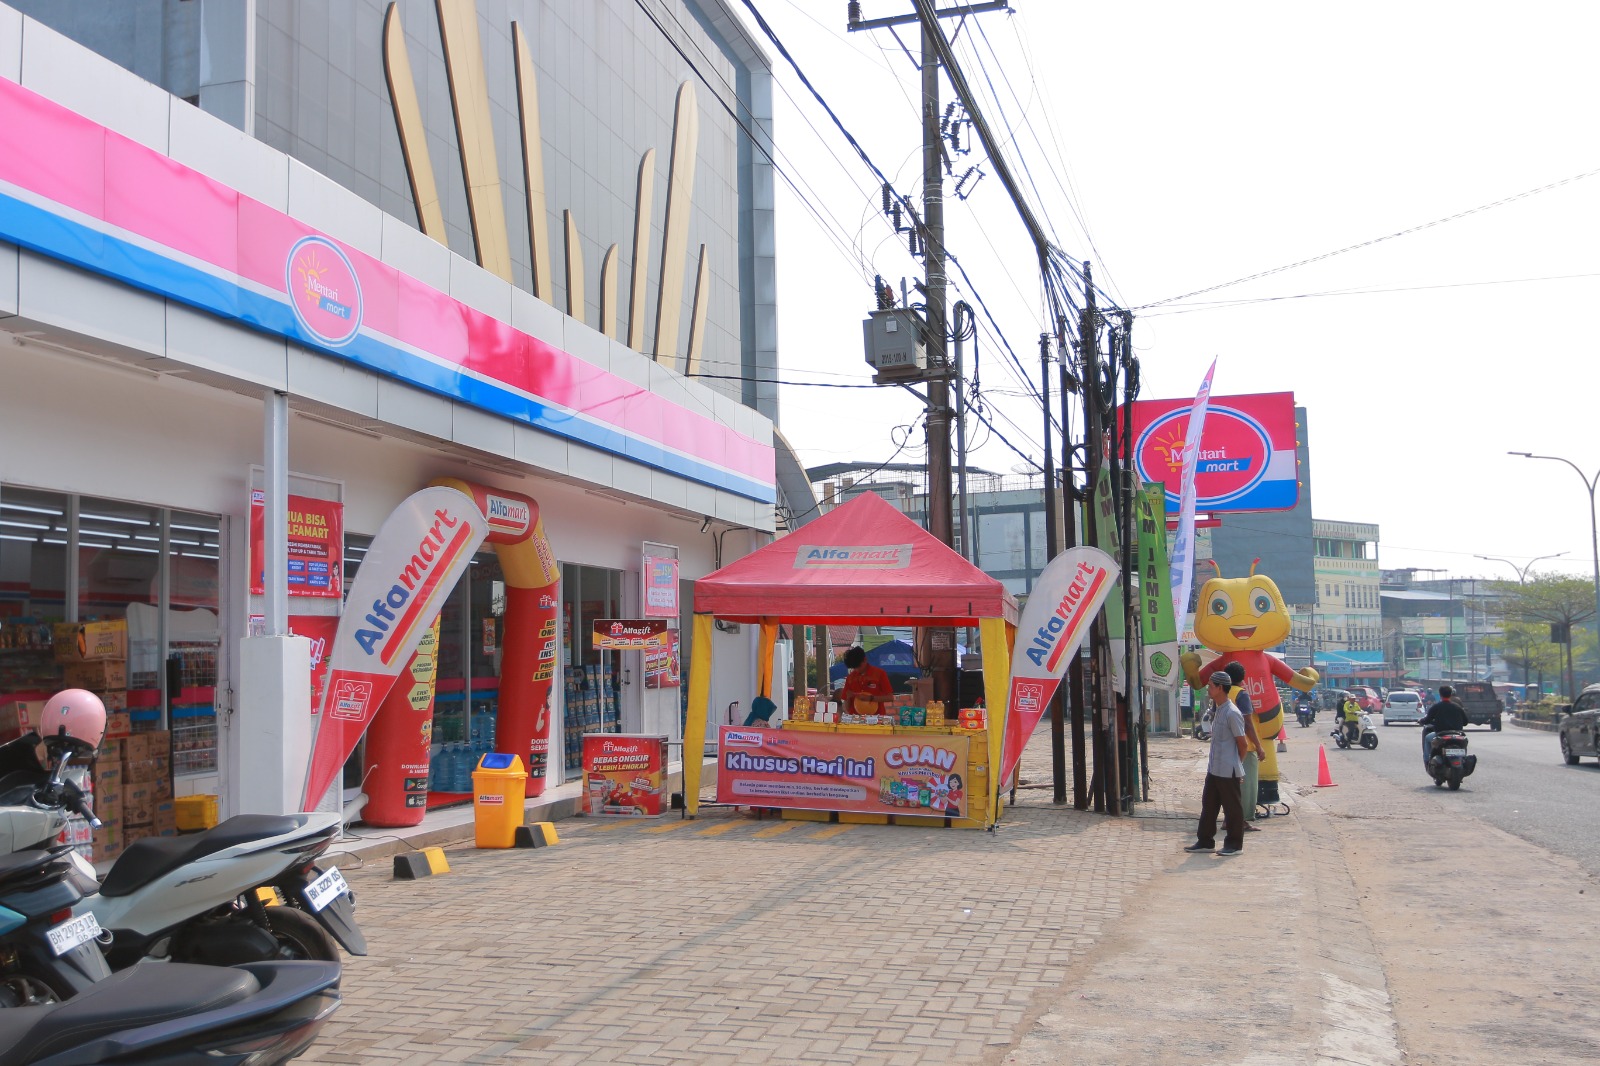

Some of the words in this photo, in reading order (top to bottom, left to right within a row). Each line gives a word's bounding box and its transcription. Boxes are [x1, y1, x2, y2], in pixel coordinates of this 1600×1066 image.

[308, 274, 338, 301] Mentari
[326, 302, 345, 317] mart
[1205, 460, 1239, 472] mart
[490, 499, 527, 520] Alfamart
[288, 511, 303, 522] UA
[306, 513, 327, 526] BISA
[288, 525, 329, 538] LFAMART
[808, 548, 899, 559] Alfamart
[354, 508, 457, 655] Alfamart
[1146, 547, 1159, 632] JAMBI
[1026, 561, 1095, 667] Alfamart
[623, 626, 651, 635] Alfagift
[727, 732, 760, 742] Alfamart
[613, 745, 638, 753] Alfagift
[593, 756, 618, 764] BEBAS
[619, 754, 649, 763] ONGKIR
[727, 753, 798, 772] Khusus
[802, 756, 843, 775] Hari
[848, 758, 873, 777] Ini
[885, 745, 956, 770] CUAN
[50, 930, 64, 945] BH
[62, 920, 85, 939] 2923
